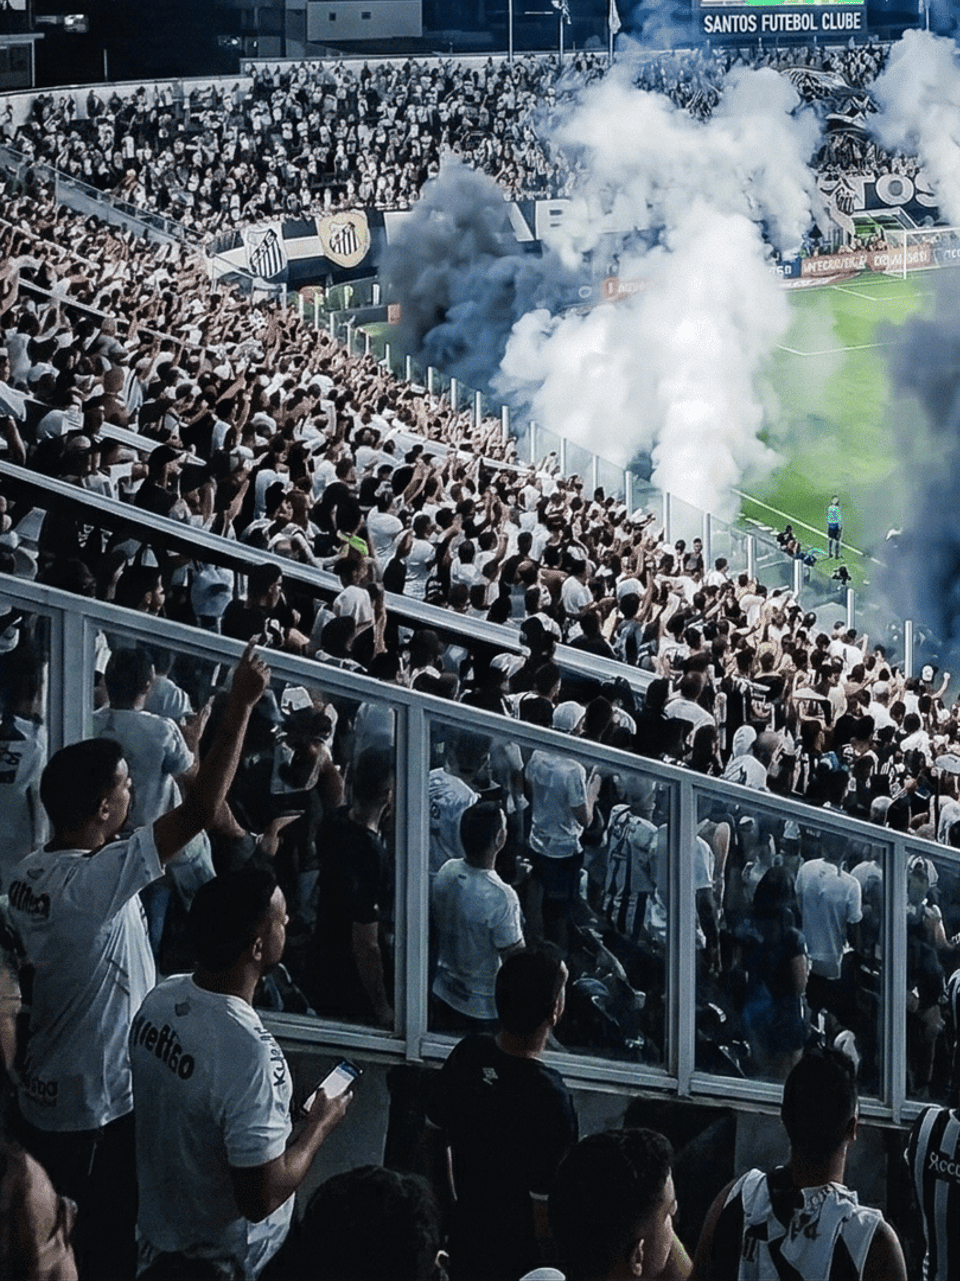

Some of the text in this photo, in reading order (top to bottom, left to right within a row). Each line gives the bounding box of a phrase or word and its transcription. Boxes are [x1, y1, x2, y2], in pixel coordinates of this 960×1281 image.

[703, 11, 862, 34] SANTOS FUTEBOL CLUBE
